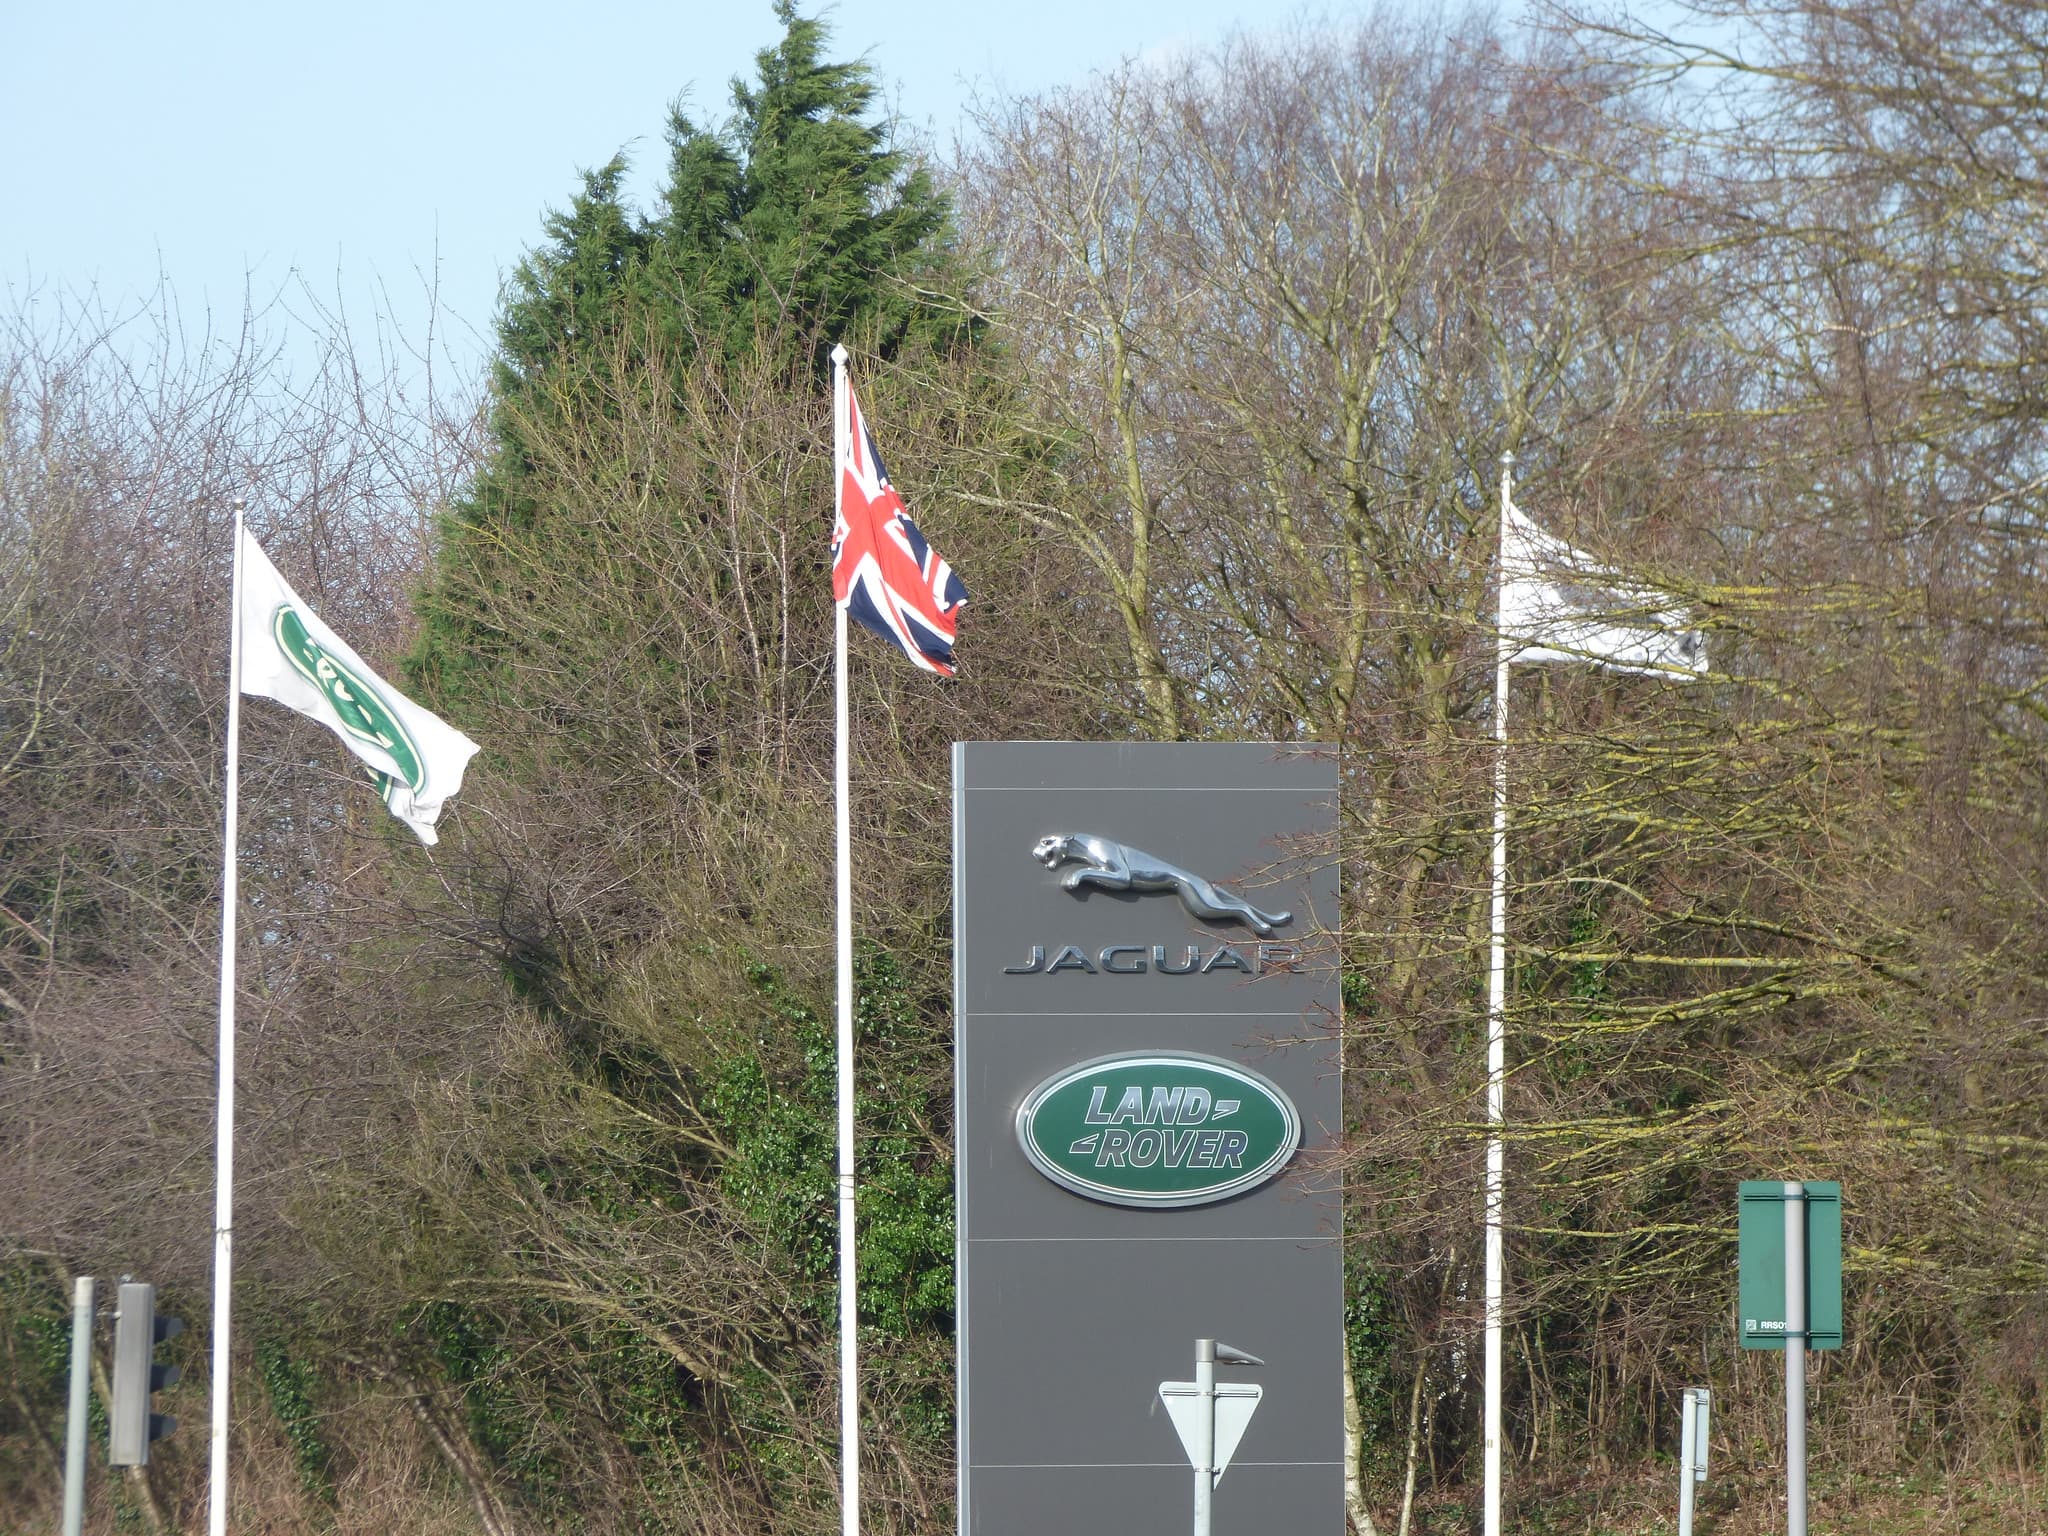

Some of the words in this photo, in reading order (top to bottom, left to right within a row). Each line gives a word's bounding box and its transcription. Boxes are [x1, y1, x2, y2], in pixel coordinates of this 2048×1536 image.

[1003, 944, 1304, 975] JAGUAR
[1084, 1085, 1212, 1126] LAND
[1094, 1128, 1249, 1169] ROVER
